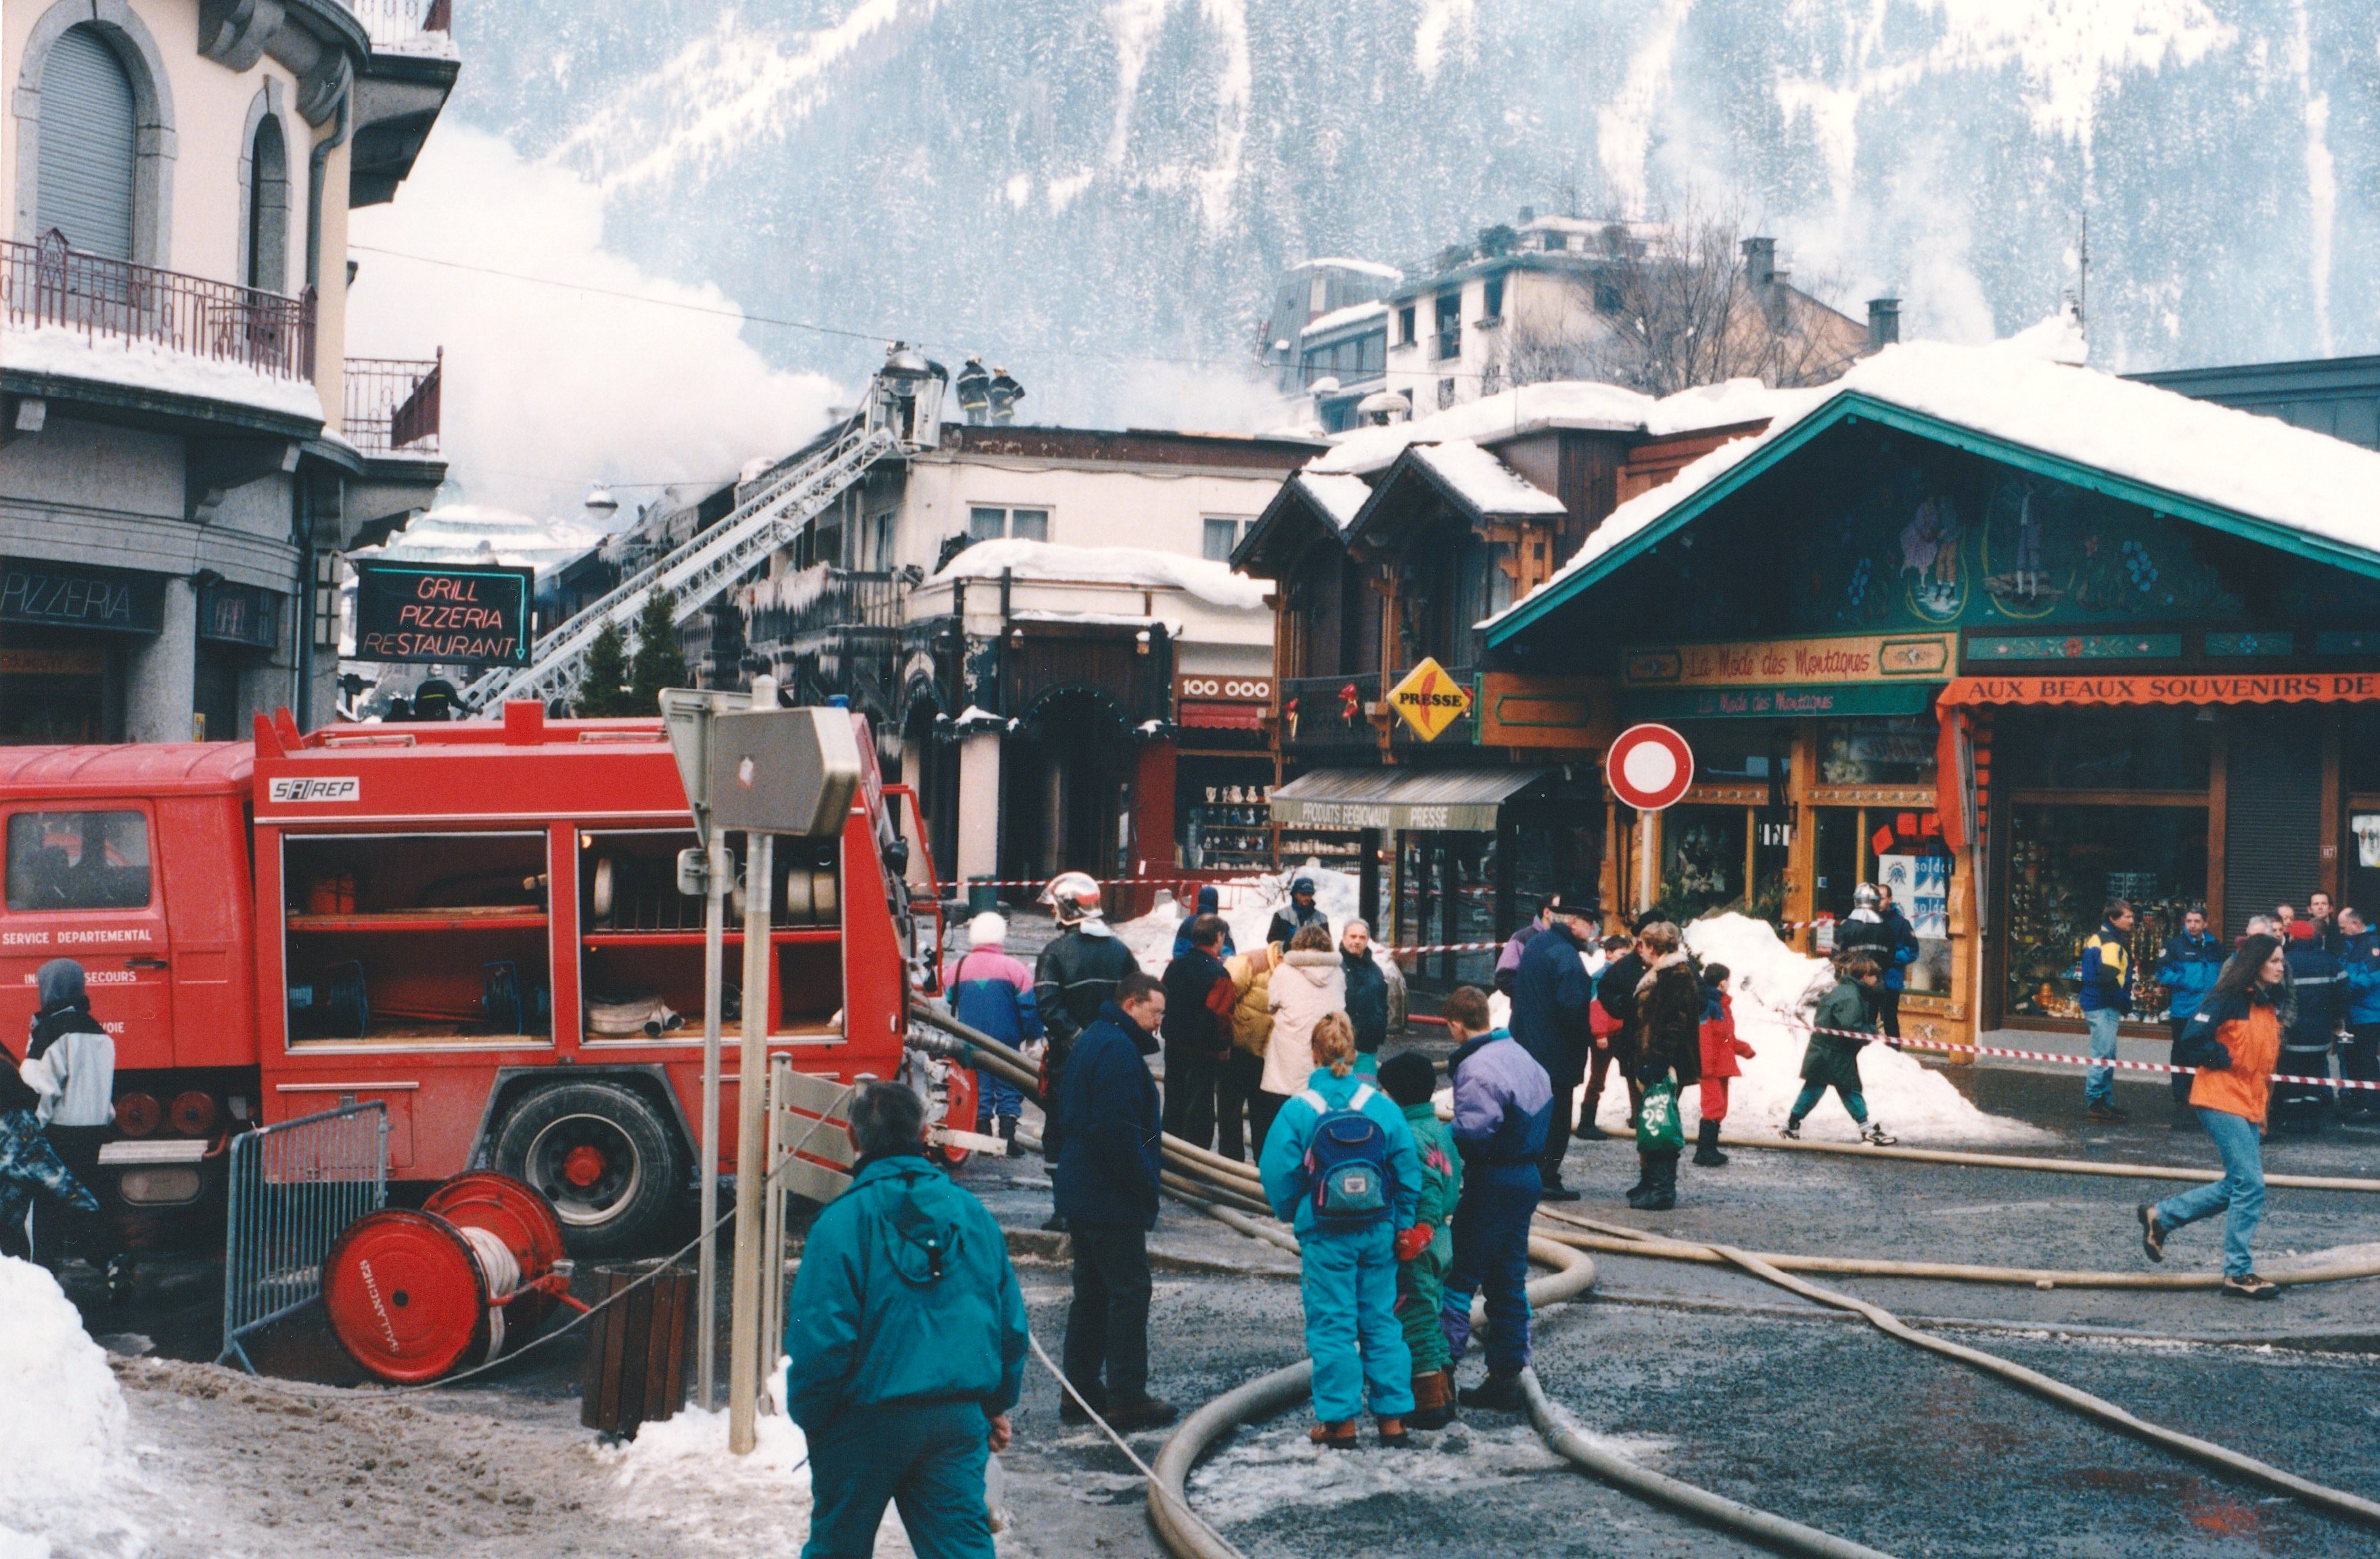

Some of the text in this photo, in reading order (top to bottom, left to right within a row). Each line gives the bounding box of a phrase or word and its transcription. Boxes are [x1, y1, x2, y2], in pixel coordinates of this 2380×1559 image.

[0, 572, 130, 619] PIZZERIA
[417, 577, 478, 602] GRILL
[399, 605, 503, 630] PIZZERIA
[363, 633, 516, 658] RESTAURANT
[1690, 646, 1871, 679] La Mode des Montagnes
[1183, 679, 1270, 698] 100 000
[1400, 692, 1462, 707] PRESSE
[1968, 677, 2374, 698] AUX BEAUX SOUVENIRS DE
[1775, 692, 1833, 715] Montagnes
[1302, 803, 1448, 828] PRODUITS REGIONAUX PRESSE
[2, 929, 152, 945] SERVICE DEPARTEMENTAL
[84, 970, 137, 983] SECOURS
[360, 1259, 399, 1352] SALLANCHES
